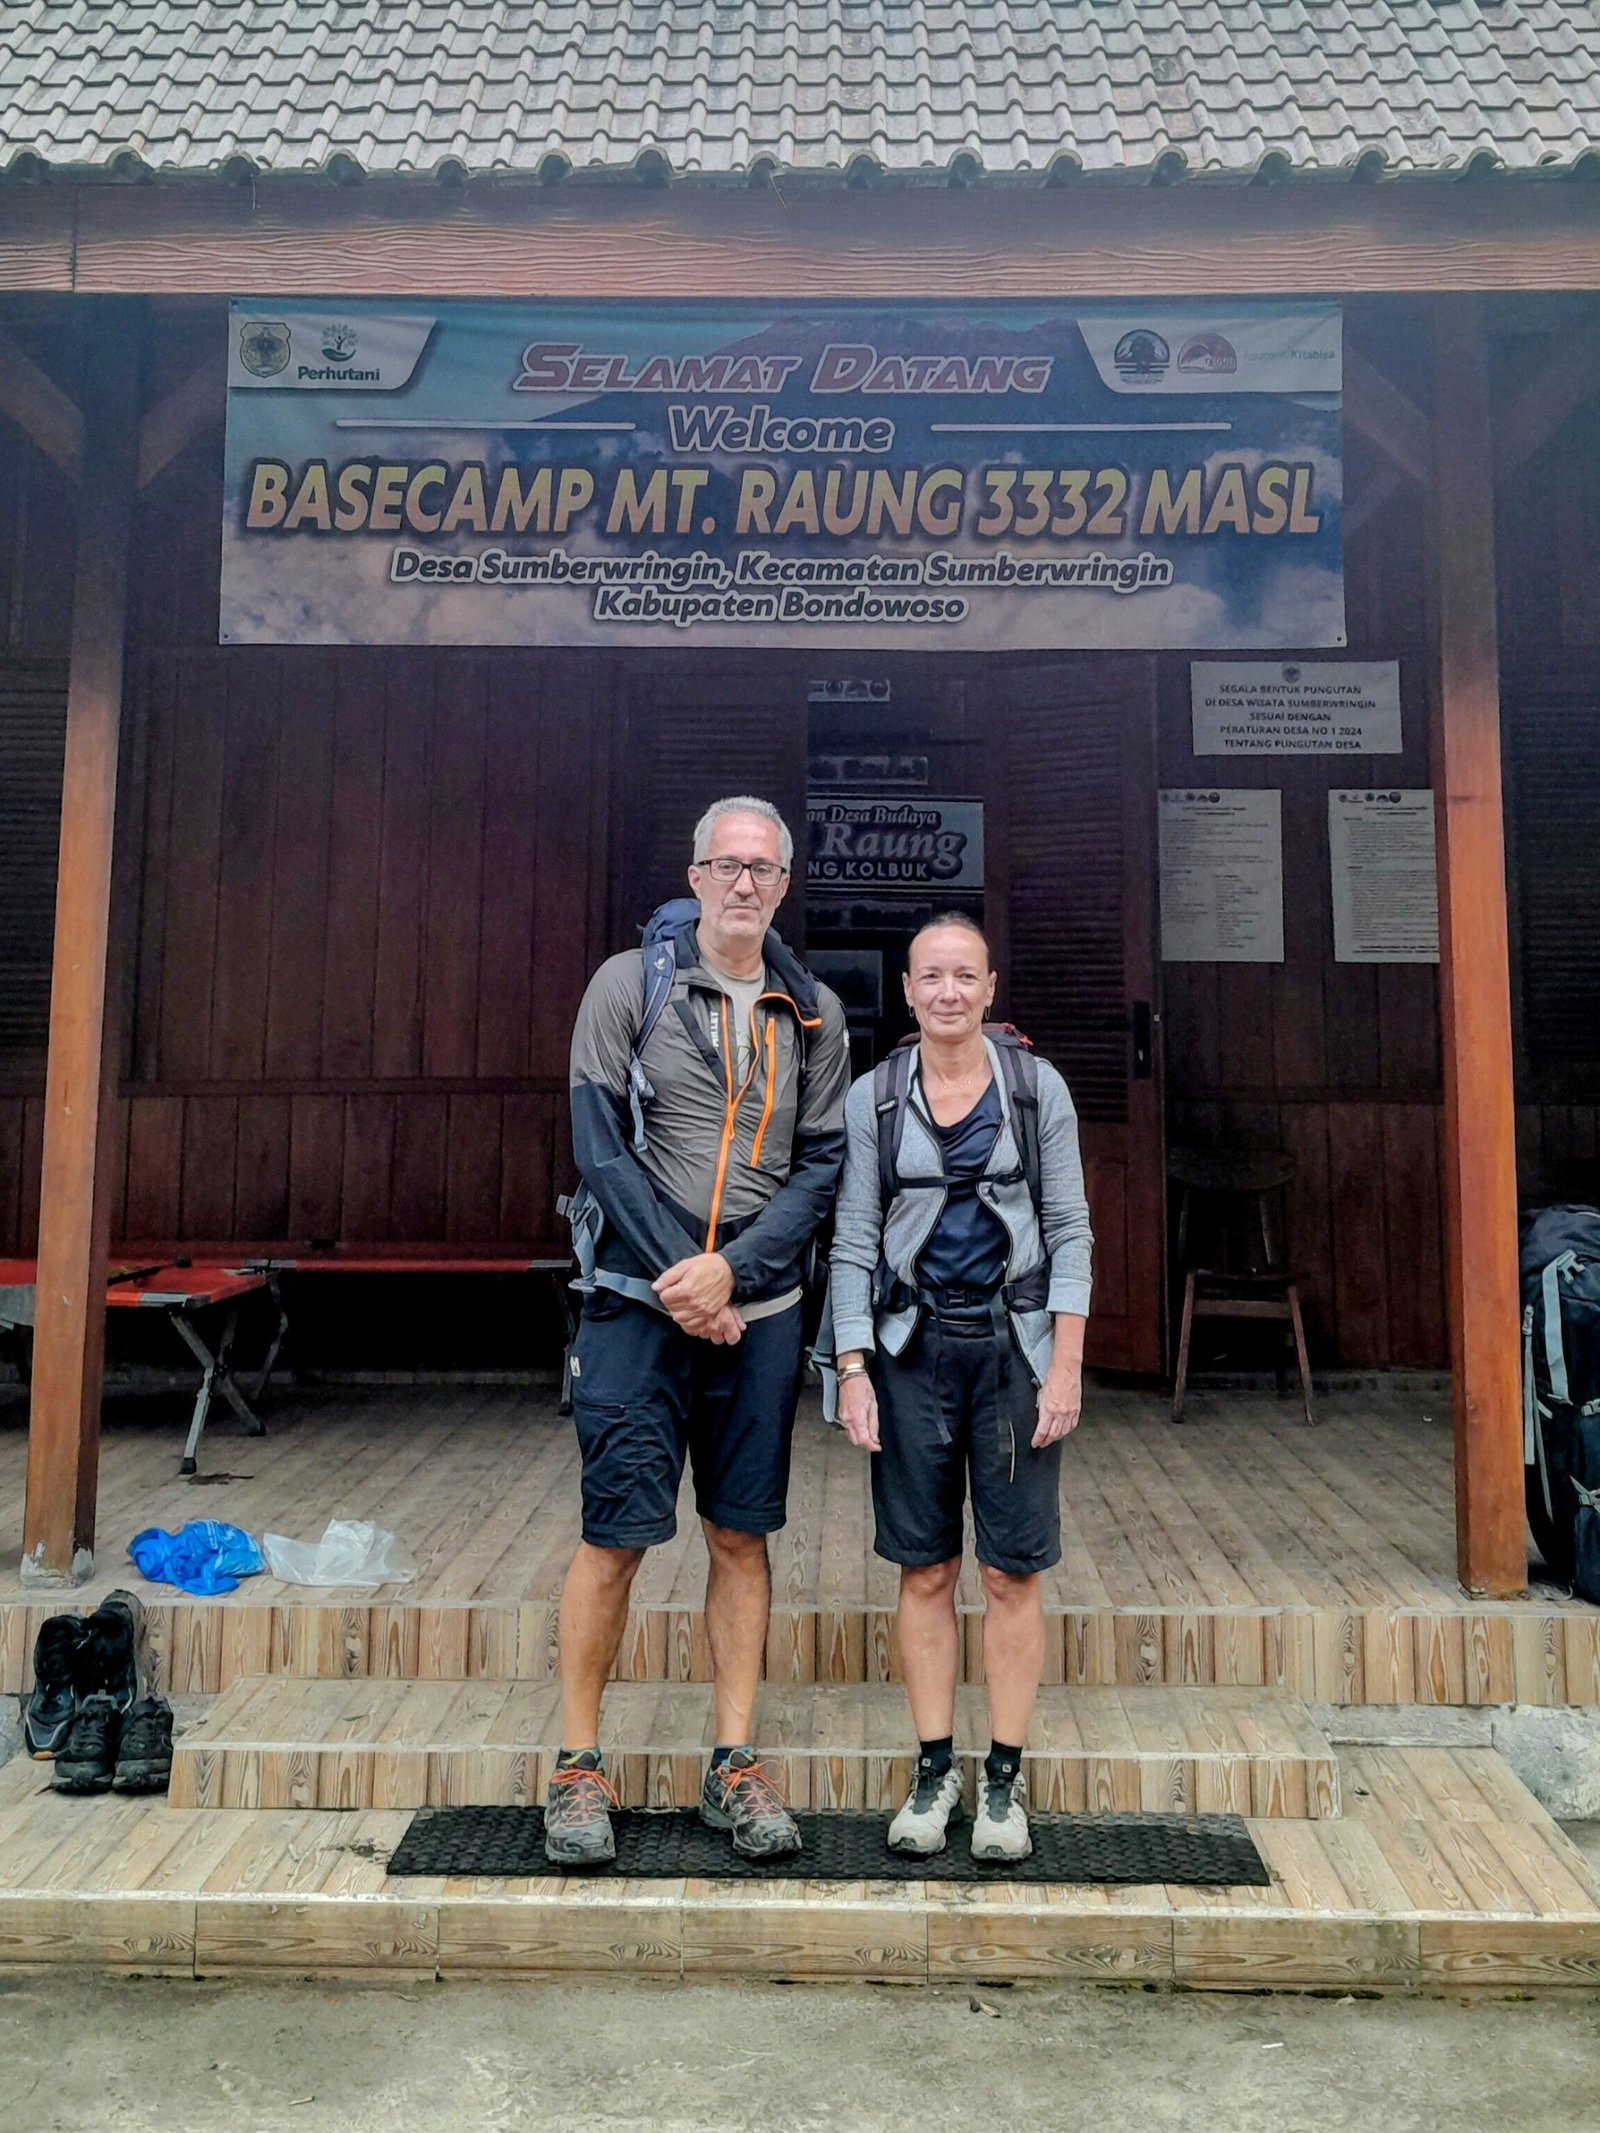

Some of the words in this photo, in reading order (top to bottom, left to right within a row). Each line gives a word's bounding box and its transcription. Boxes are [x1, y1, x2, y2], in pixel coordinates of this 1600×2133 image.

[298, 366, 380, 382] Perhutani
[513, 341, 802, 393] SELAMAT
[810, 343, 1055, 393] DATANG
[668, 405, 896, 453] Welcome
[246, 463, 595, 533] BASECAMP
[606, 468, 716, 534] MT.
[735, 468, 963, 536] RAUNG
[977, 467, 1128, 536] 3332
[1139, 466, 1320, 536] MASL
[392, 550, 476, 580] Desa
[482, 551, 732, 588] Sumberwringin,
[738, 553, 921, 583] Kecamatan
[927, 553, 1171, 590] Sumberwringin
[597, 588, 775, 623] Kabupaten
[782, 590, 966, 619] Bondowoso
[1219, 685, 1257, 694] SEGALA
[1260, 685, 1300, 694] BENTUK
[1303, 685, 1361, 694] PUNGUTAN
[1205, 699, 1215, 707] DI
[1219, 698, 1244, 707] DESA
[1247, 698, 1285, 708] WISATA
[1288, 699, 1376, 708] SUMBERWRINGIN
[1249, 712, 1284, 721] SESUAI
[1287, 712, 1331, 721] DENGAN
[1220, 725, 1280, 735] PERATURAN
[1283, 726, 1308, 735] DESA
[1311, 726, 1328, 736] NO
[1338, 727, 1362, 736] 2024
[1224, 739, 1272, 748] TENTANG
[1274, 739, 1332, 749] PUNGUTAN
[1335, 740, 1361, 749] DESA
[831, 805, 870, 823] Desa
[873, 805, 937, 830] Budaya
[817, 822, 962, 870] Raung
[845, 862, 928, 878] KOLBUK
